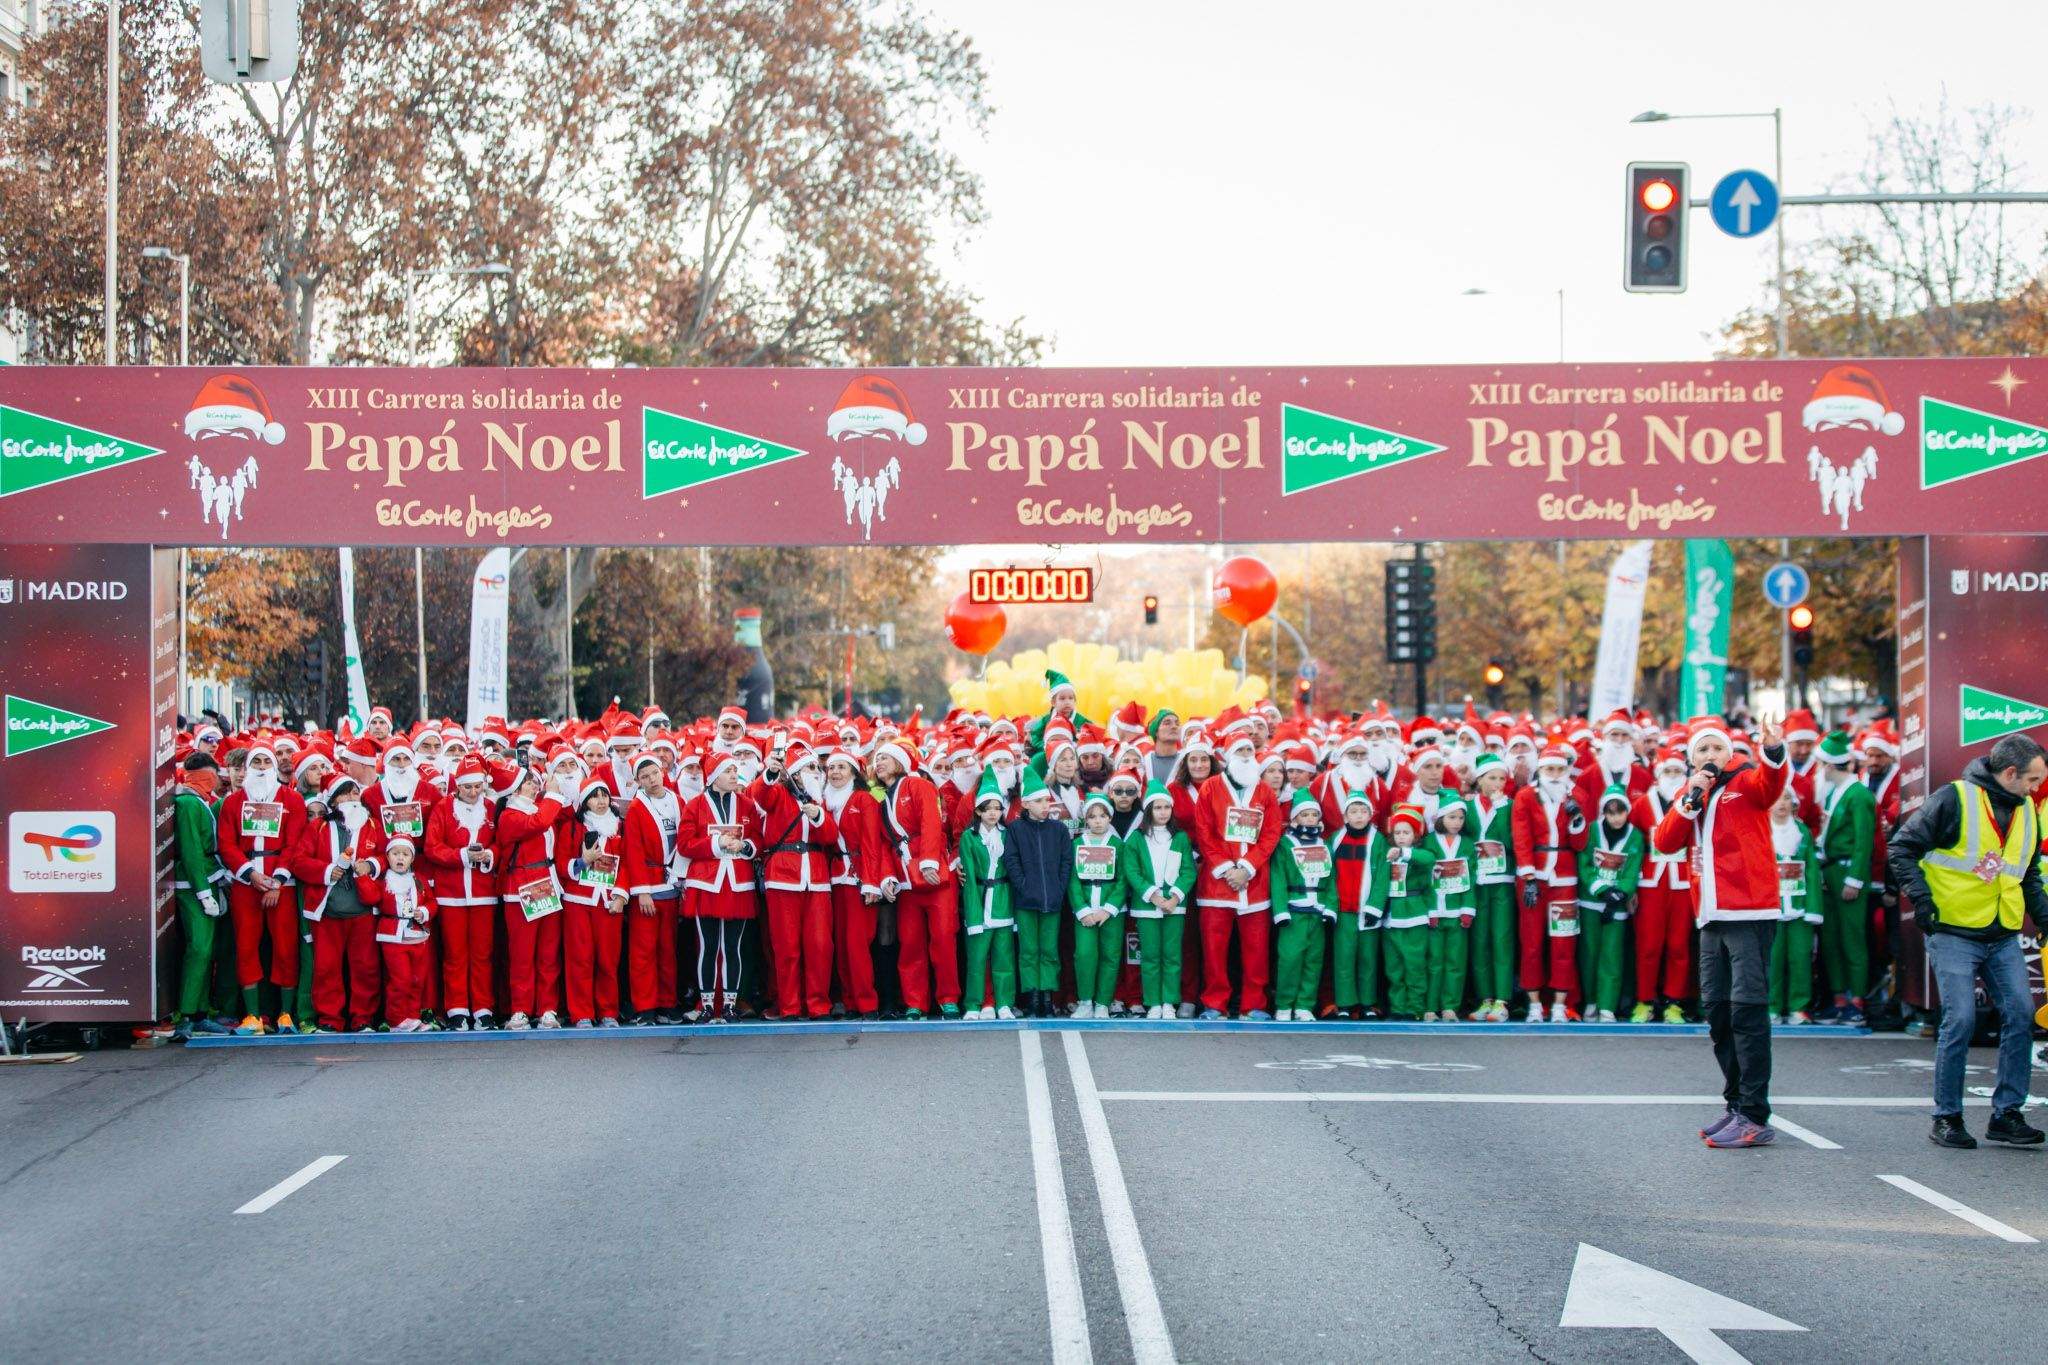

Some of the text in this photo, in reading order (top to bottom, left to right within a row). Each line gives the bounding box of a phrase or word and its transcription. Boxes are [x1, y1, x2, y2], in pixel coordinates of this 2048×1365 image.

[307, 387, 622, 410] XIII Carrera solidaria de
[948, 385, 1262, 408] XIII Carrera solidaria de
[1468, 379, 1784, 405] XIII Carrera solidaria de
[1, 434, 124, 464] El Corte Inglés
[303, 419, 626, 487] Papá Noel
[647, 435, 767, 466] El Corte Inglés
[945, 416, 1265, 487] Papá Noel
[1286, 432, 1407, 462] El Corte Inglés
[1466, 411, 1786, 482] Papá Noel
[1925, 425, 2047, 455] El Corte Inglés
[376, 494, 552, 537] El Corte Inglés
[1017, 493, 1193, 536] El Corte Inglés
[1538, 488, 1717, 531] El Corte Inglés
[28, 581, 128, 600] MADRID
[972, 570, 1088, 601] 00:00:00
[9, 715, 90, 734] El Corte Inglés
[1977, 707, 2004, 721] Corte
[23, 870, 103, 882] TotalEnergies
[22, 946, 106, 962] Reebok
